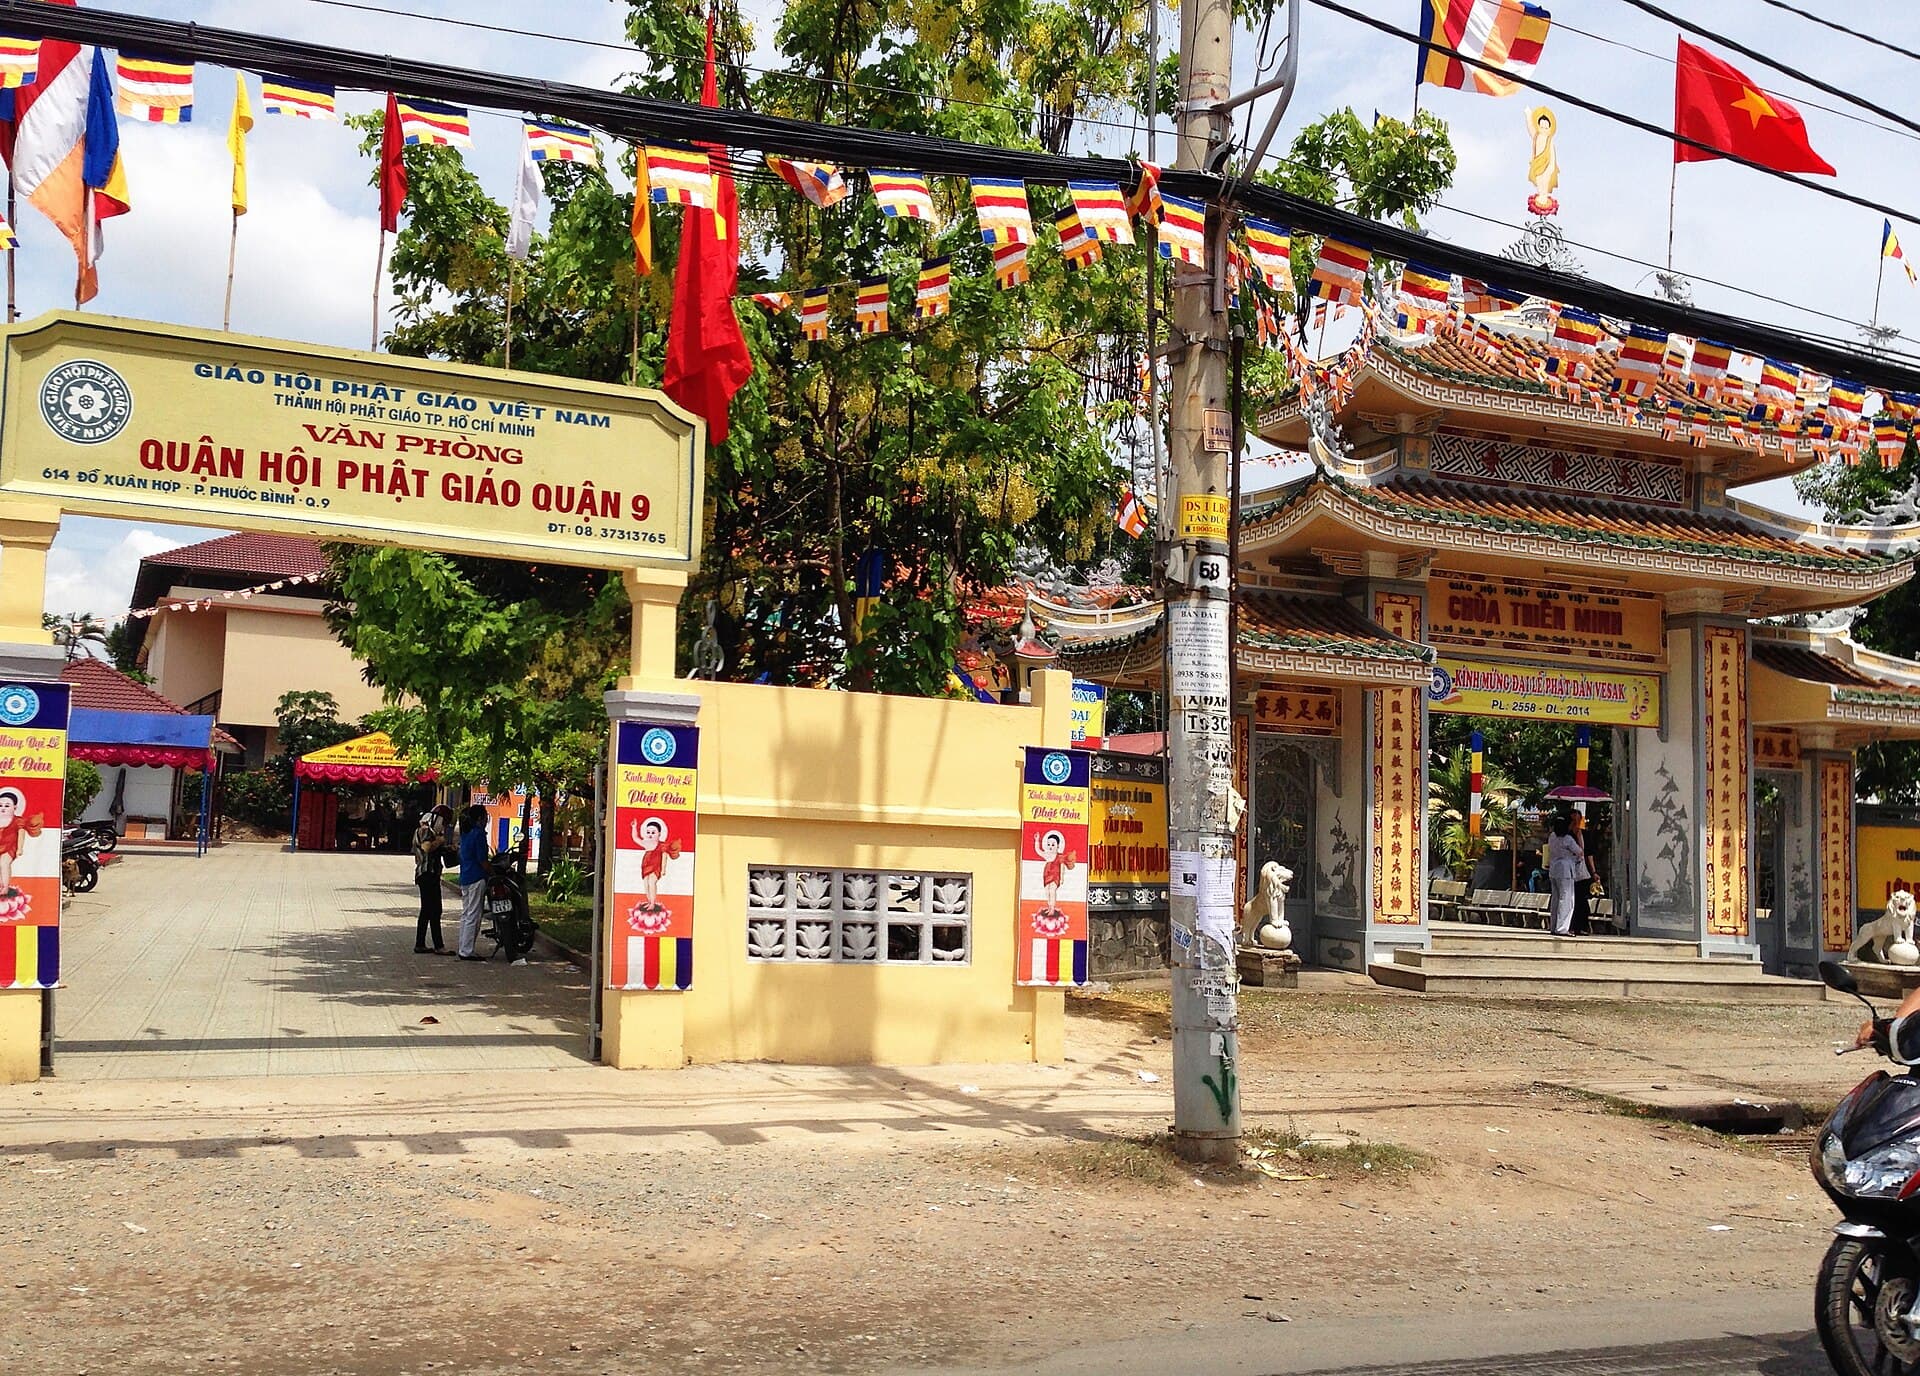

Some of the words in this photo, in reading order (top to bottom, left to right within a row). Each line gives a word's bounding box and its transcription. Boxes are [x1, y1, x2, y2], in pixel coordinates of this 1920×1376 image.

[194, 362, 265, 384] GIÁO
[274, 372, 321, 395] HỘI
[332, 382, 406, 404] PHẬT
[416, 391, 478, 412] GIÁO
[488, 400, 546, 421] VIỆT
[555, 410, 610, 428] NAM
[83, 421, 116, 437] NAM
[325, 398, 346, 416] HỘI
[350, 402, 386, 420] PHẬT
[389, 406, 421, 423] GIÁO
[425, 412, 445, 427] TP.
[448, 414, 470, 429] HỒ
[472, 417, 495, 433] CHÍ
[499, 422, 535, 437] MINH
[302, 422, 386, 449] VĂN
[396, 435, 523, 465] PHÒNG
[42, 468, 70, 481] 614
[76, 468, 100, 483] ĐỖ
[103, 474, 148, 489] XUÂN
[151, 480, 181, 493] HỢP
[194, 484, 206, 496] P.
[210, 485, 257, 501] PHƯỚC
[260, 488, 295, 505] BÌNH
[140, 435, 244, 483] QUẬN
[260, 446, 321, 493] HỘI
[337, 458, 430, 503] PHẬT
[441, 467, 521, 508] GIÁO
[531, 480, 621, 523] QUẬN
[631, 494, 651, 522] 9
[1199, 560, 1220, 581] 58
[1448, 592, 1501, 624] CHÙA
[1574, 607, 1623, 636] MINH
[1196, 671, 1210, 679] 756
[1455, 665, 1480, 689] KÍNH
[1512, 674, 1531, 697] ĐẠI
[1595, 680, 1626, 701] VESAK
[1072, 686, 1097, 703] ỪNG
[1491, 699, 1509, 710] PL:
[1512, 702, 1537, 713] 2558
[1566, 705, 1590, 716] 2014
